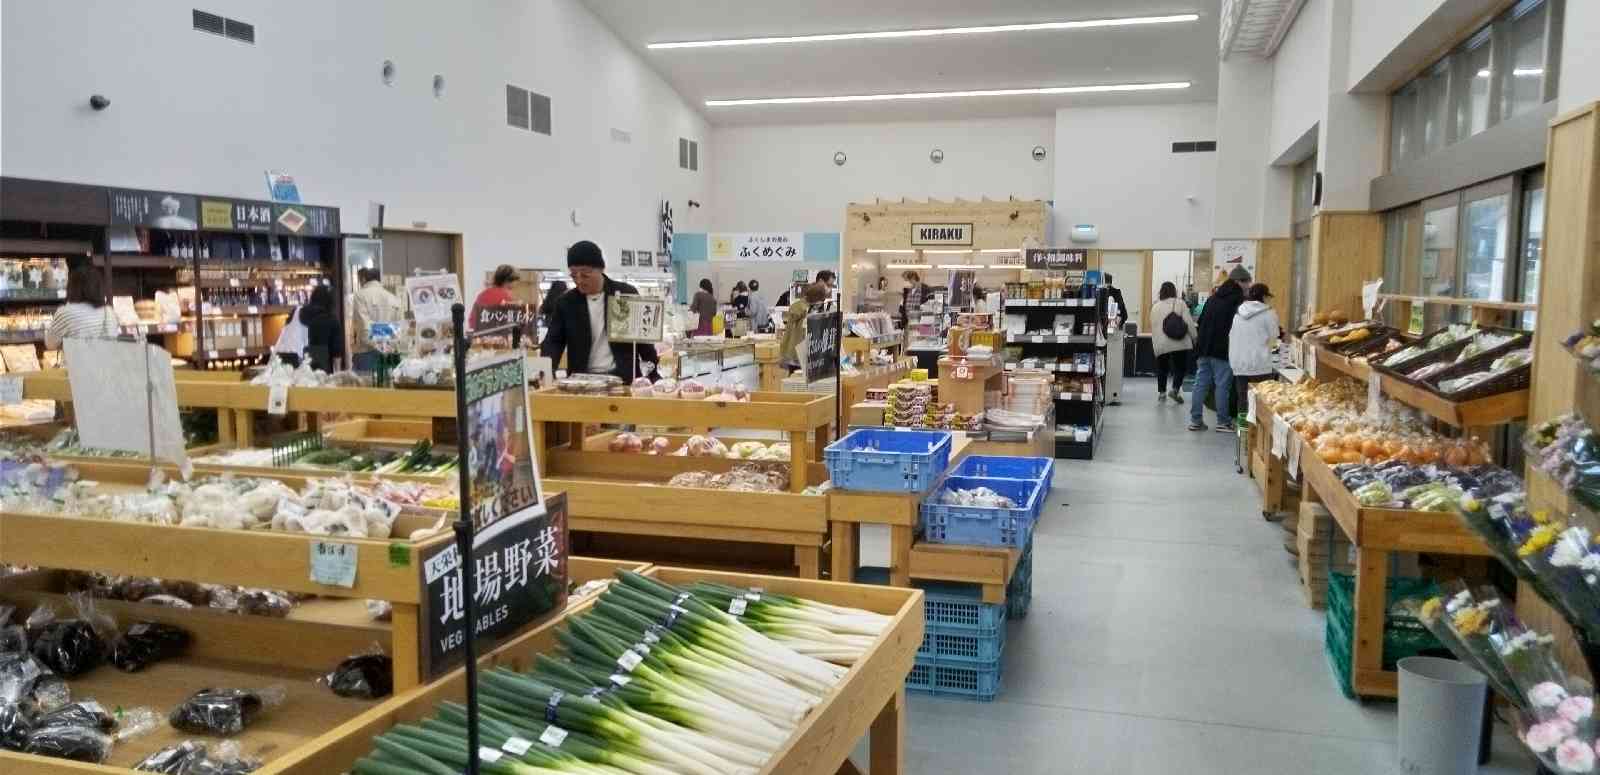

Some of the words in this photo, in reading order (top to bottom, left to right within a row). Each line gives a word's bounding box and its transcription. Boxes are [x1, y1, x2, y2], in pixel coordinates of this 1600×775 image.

[237, 204, 270, 224] 日本酒
[920, 228, 963, 241] KIRAKU
[740, 246, 797, 258] ふくめぐみ
[440, 526, 559, 625] 地場野菜
[440, 605, 509, 652] VEGABLES
